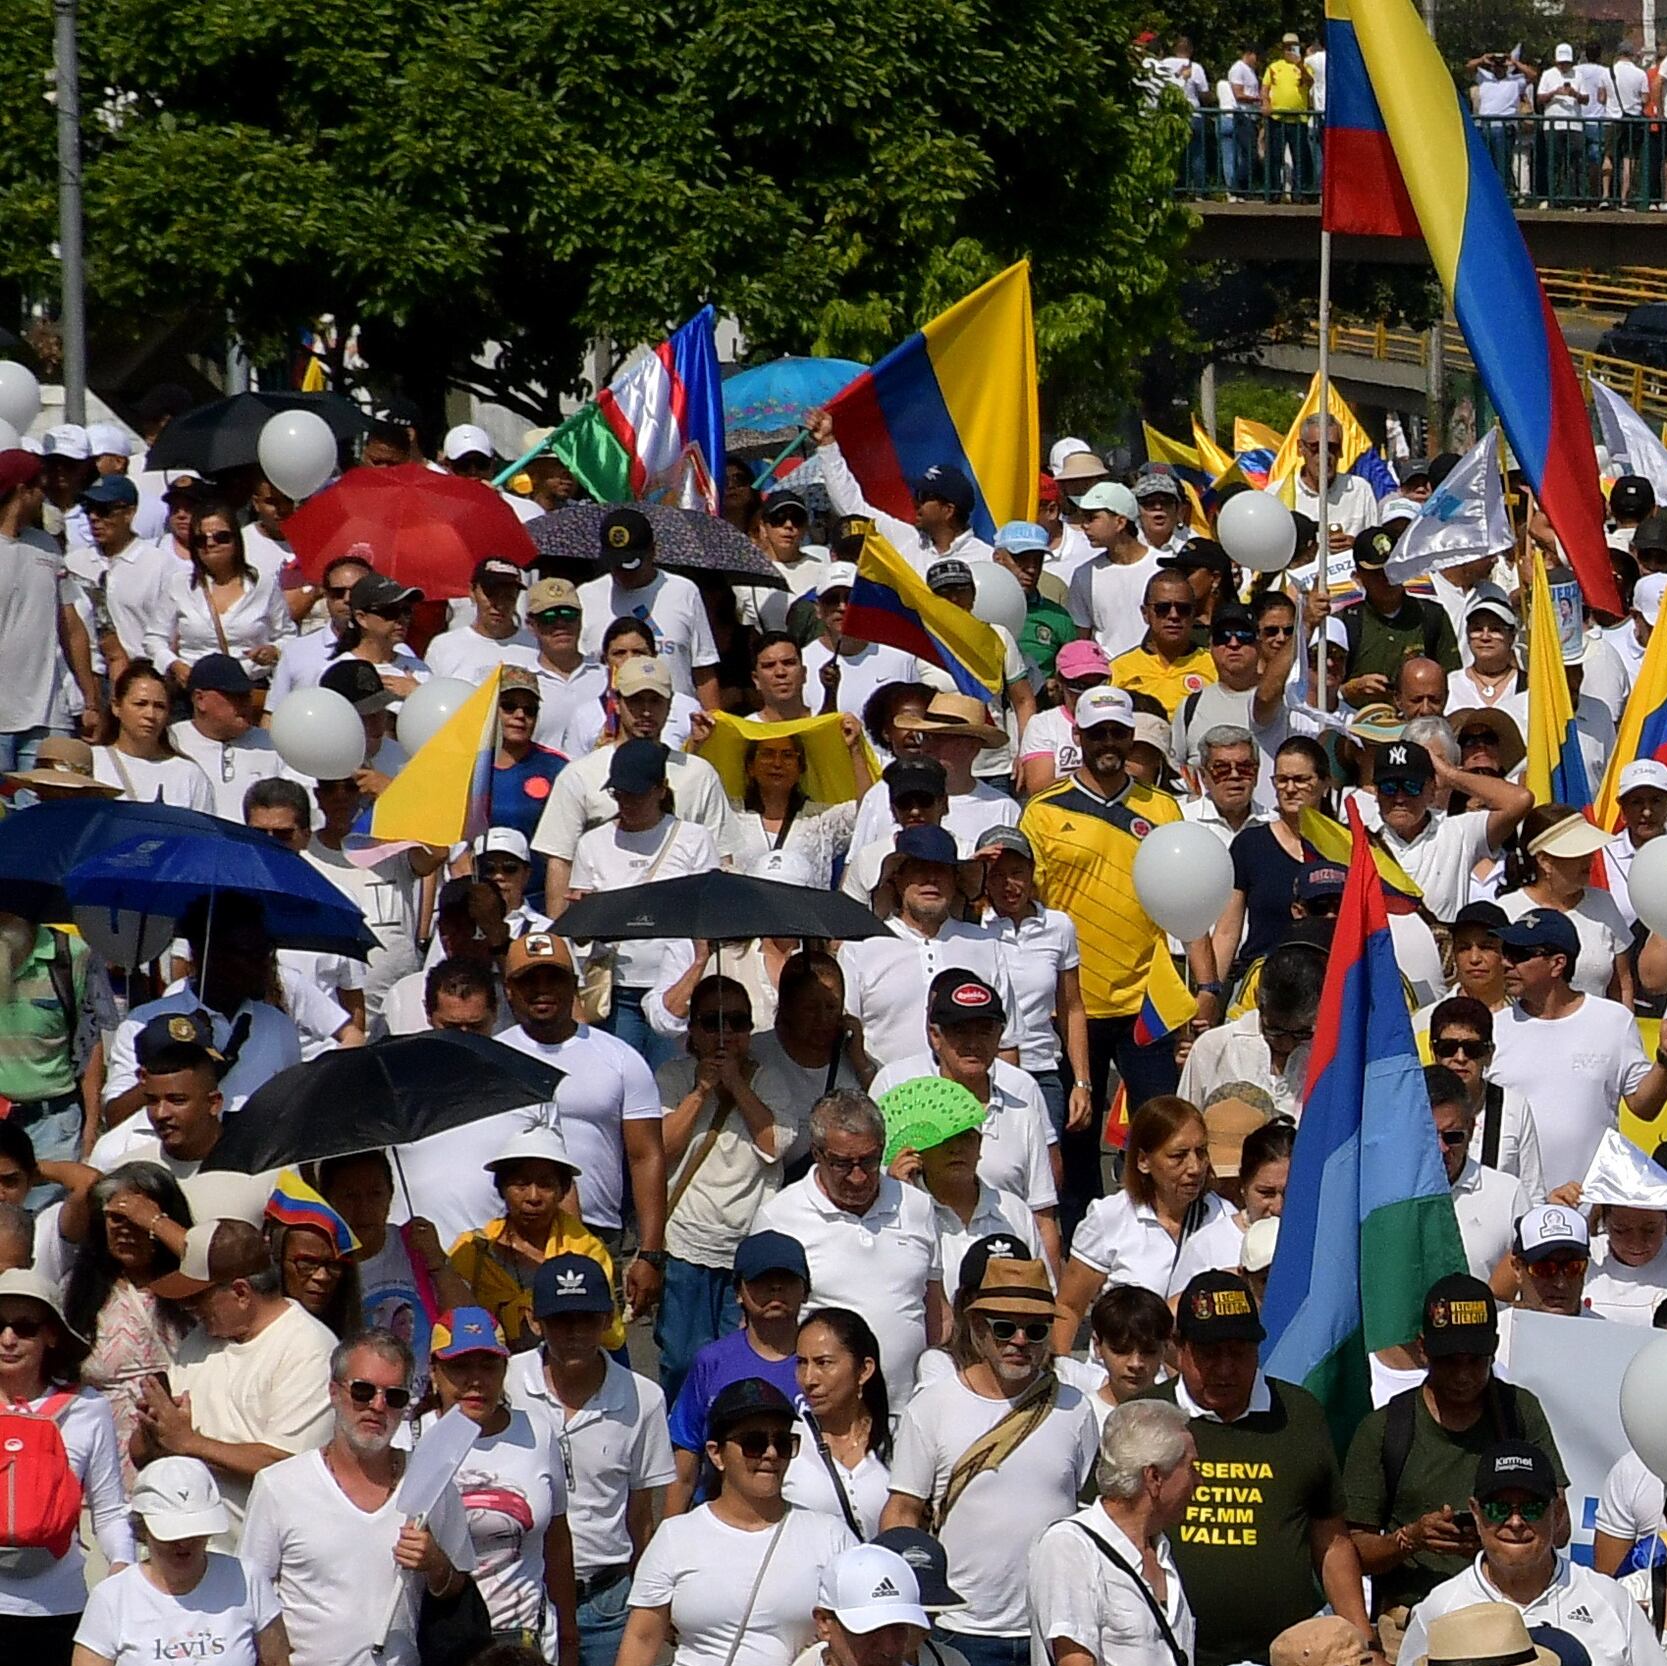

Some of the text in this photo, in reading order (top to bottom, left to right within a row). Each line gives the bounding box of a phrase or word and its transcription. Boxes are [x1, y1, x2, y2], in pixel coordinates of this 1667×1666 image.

[1194, 1461, 1274, 1481] SERVA
[1193, 1485, 1264, 1504] CTIVA
[1187, 1508, 1254, 1525] FF.MM
[1180, 1526, 1258, 1546] VALLE
